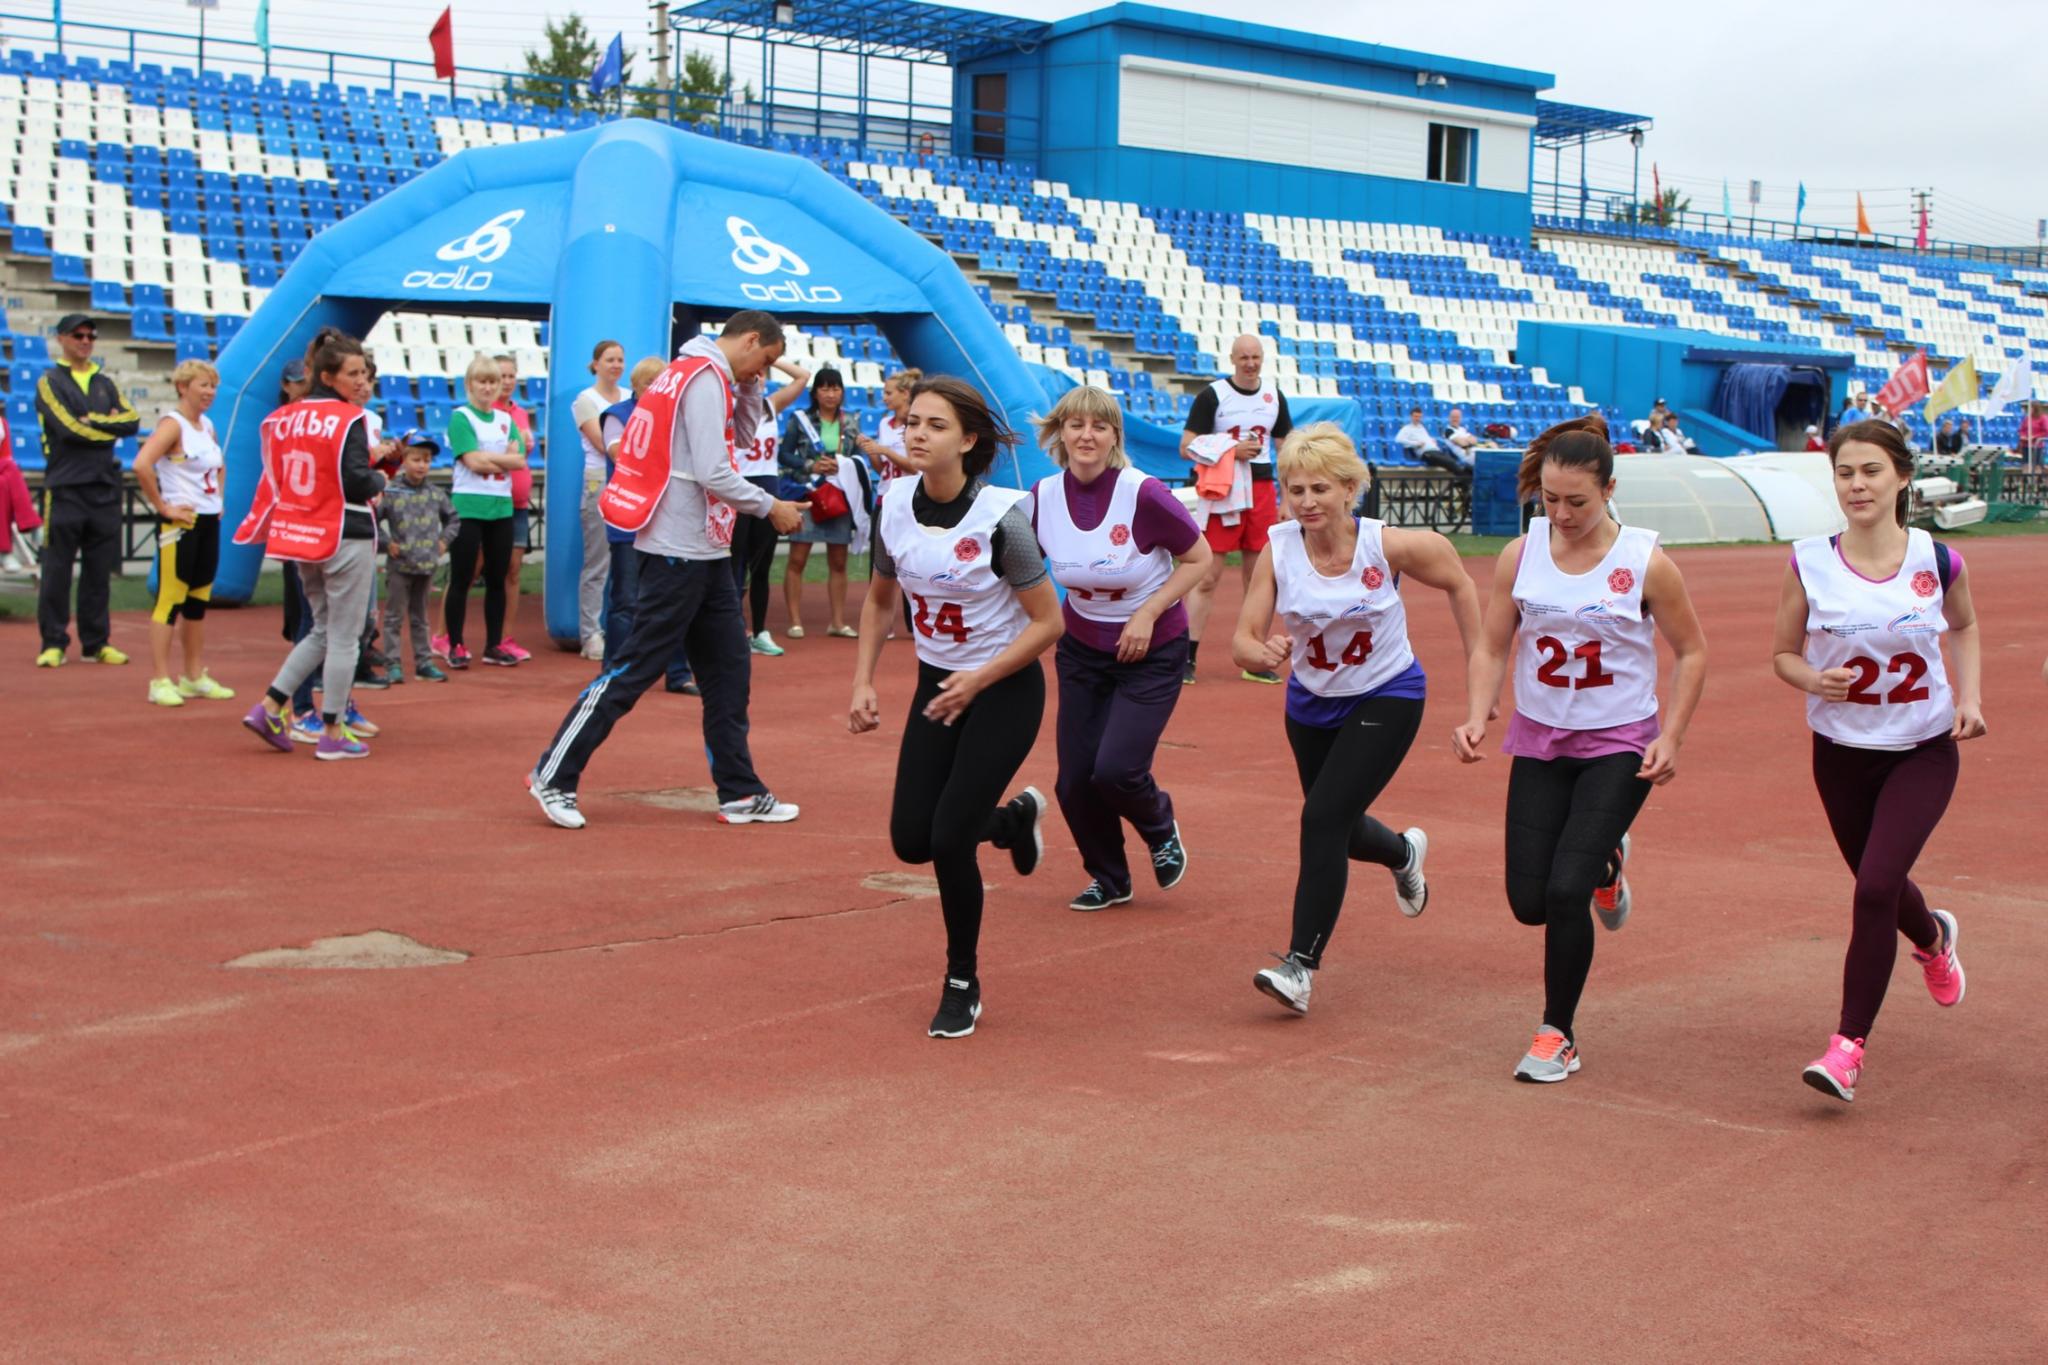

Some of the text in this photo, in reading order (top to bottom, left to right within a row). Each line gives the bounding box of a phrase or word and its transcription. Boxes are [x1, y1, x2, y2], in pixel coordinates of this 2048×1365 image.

[402, 265, 494, 291] odlo
[740, 280, 843, 303] odlo
[745, 437, 775, 461] 38
[912, 592, 974, 643] 24
[1307, 632, 1373, 672] 14
[1536, 635, 1614, 690] 21
[1842, 652, 1929, 705] 22
